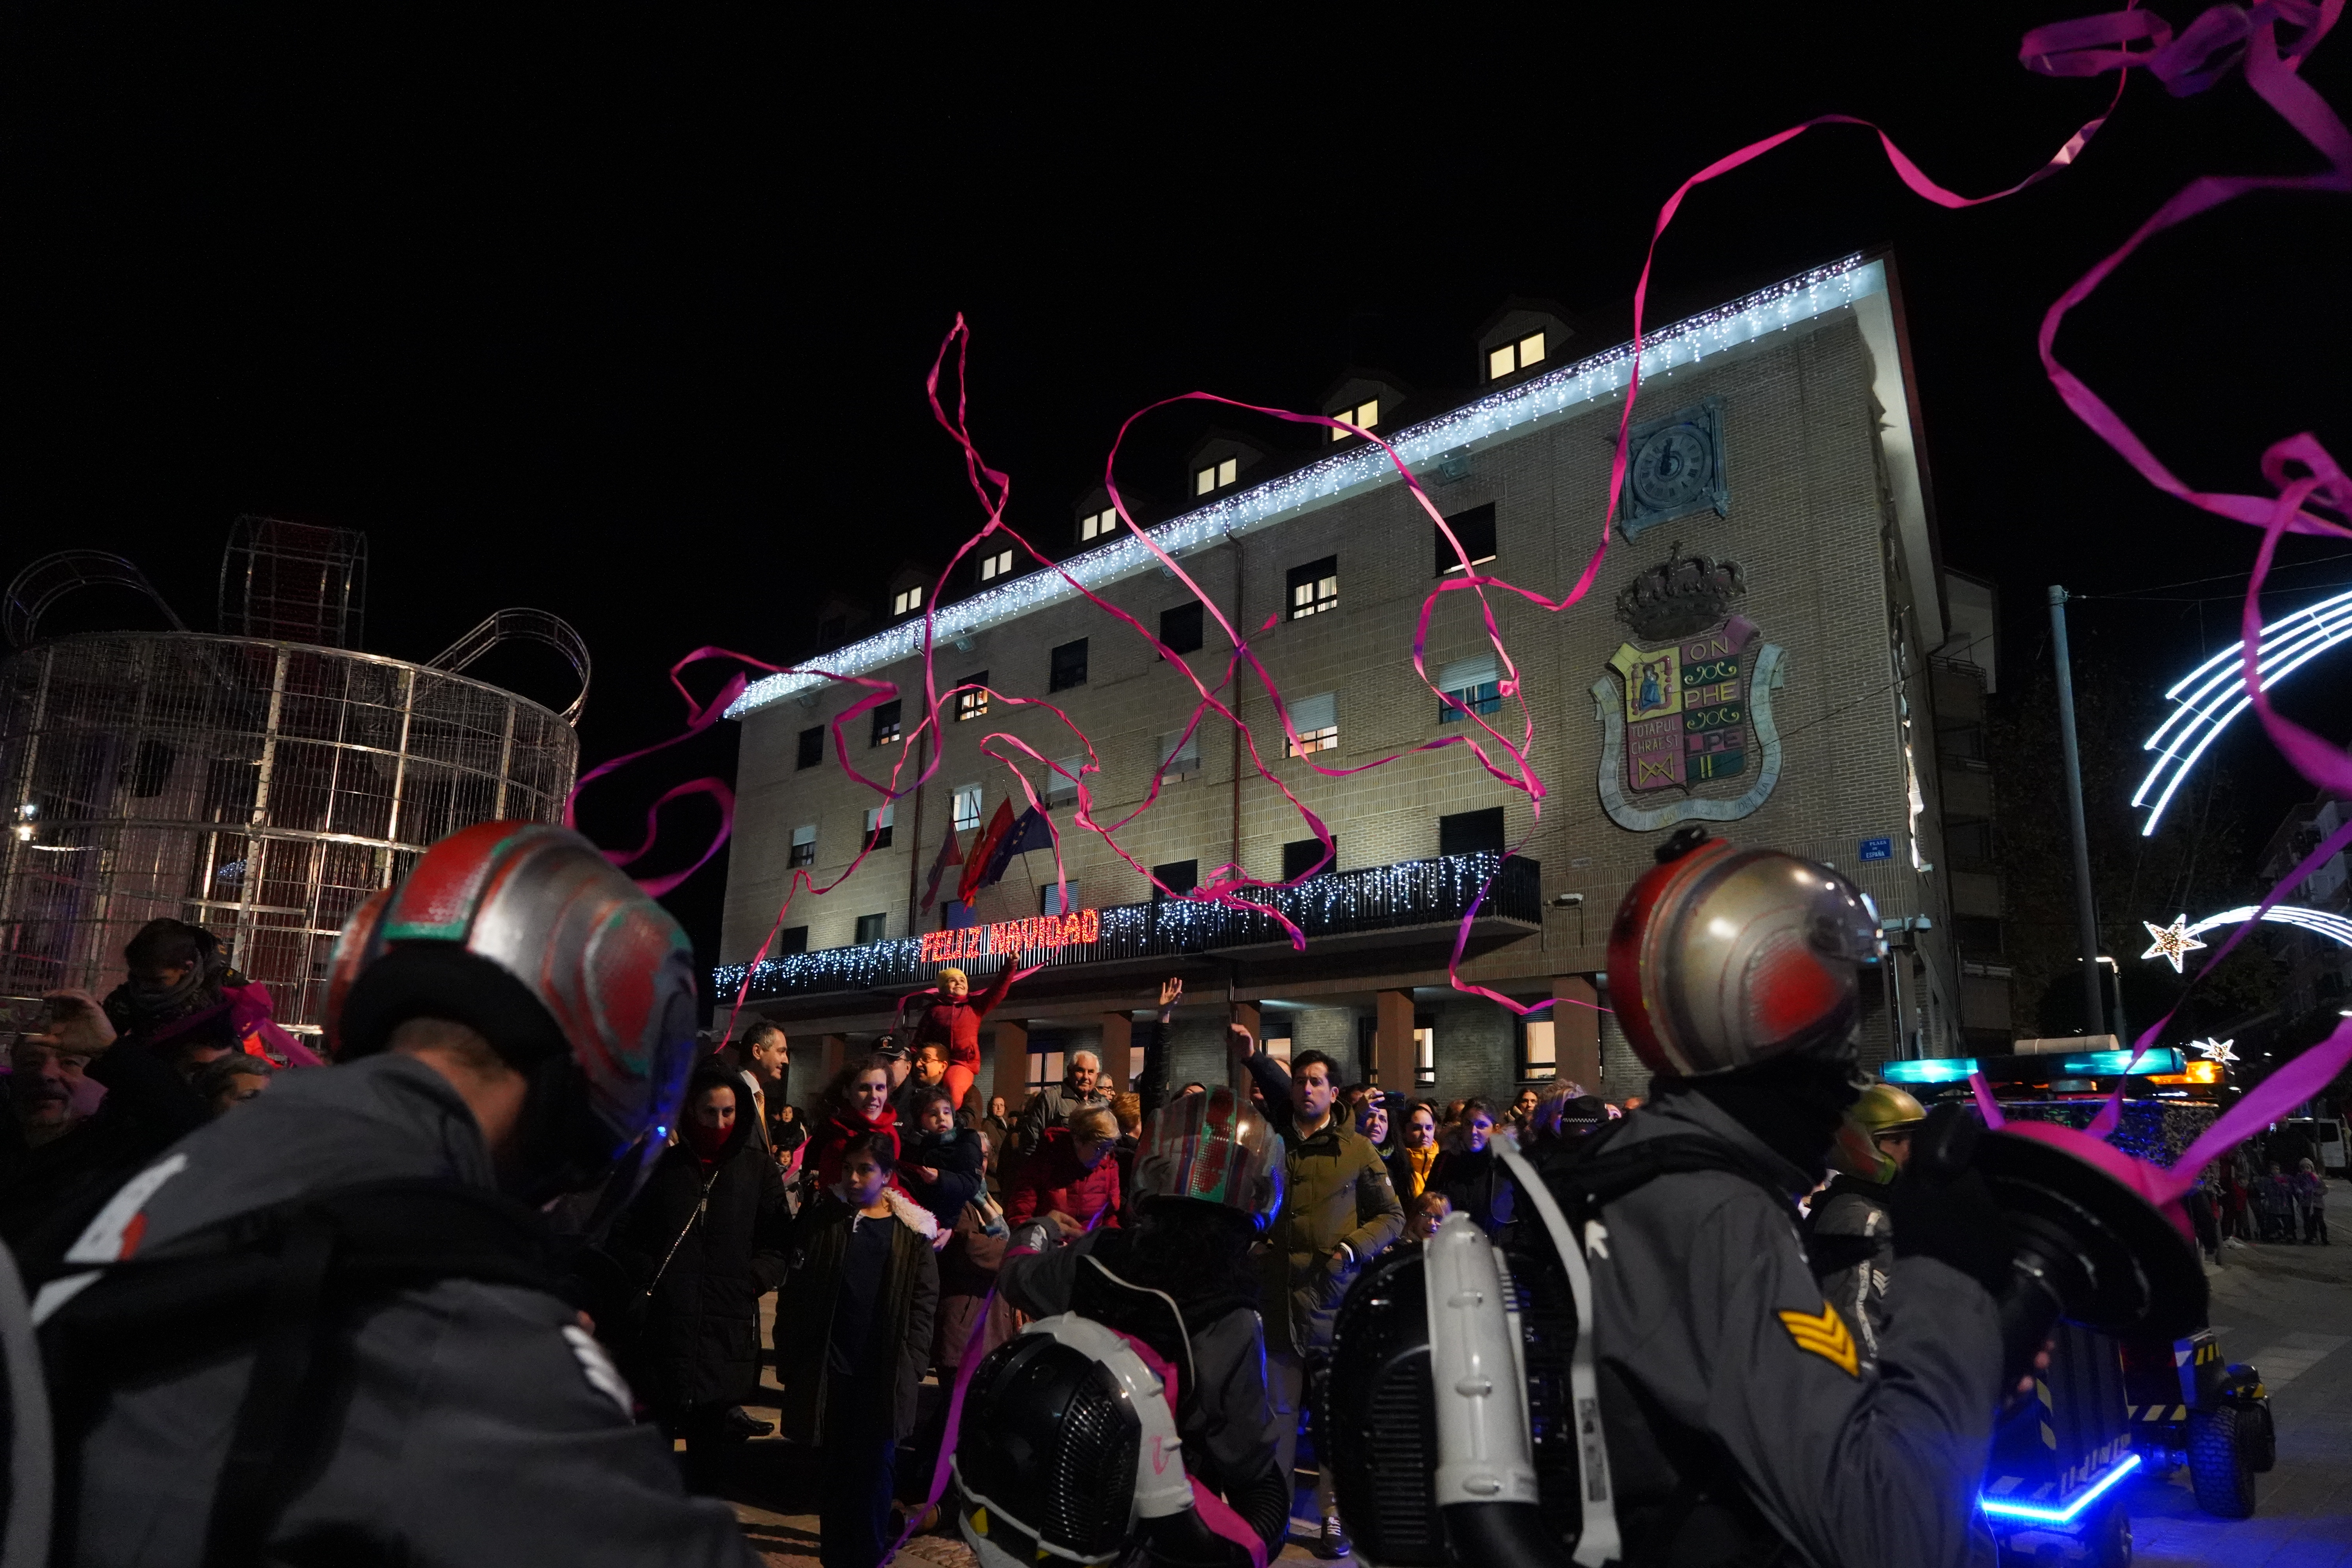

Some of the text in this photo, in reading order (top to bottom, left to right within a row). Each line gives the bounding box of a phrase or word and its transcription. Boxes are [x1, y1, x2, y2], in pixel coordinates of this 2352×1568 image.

[1690, 637, 1728, 661] ON
[1684, 682, 1737, 708] PHE
[1866, 850, 1885, 858] ESPAÑA
[921, 909, 1098, 962] FELIZ NAVIDAD
